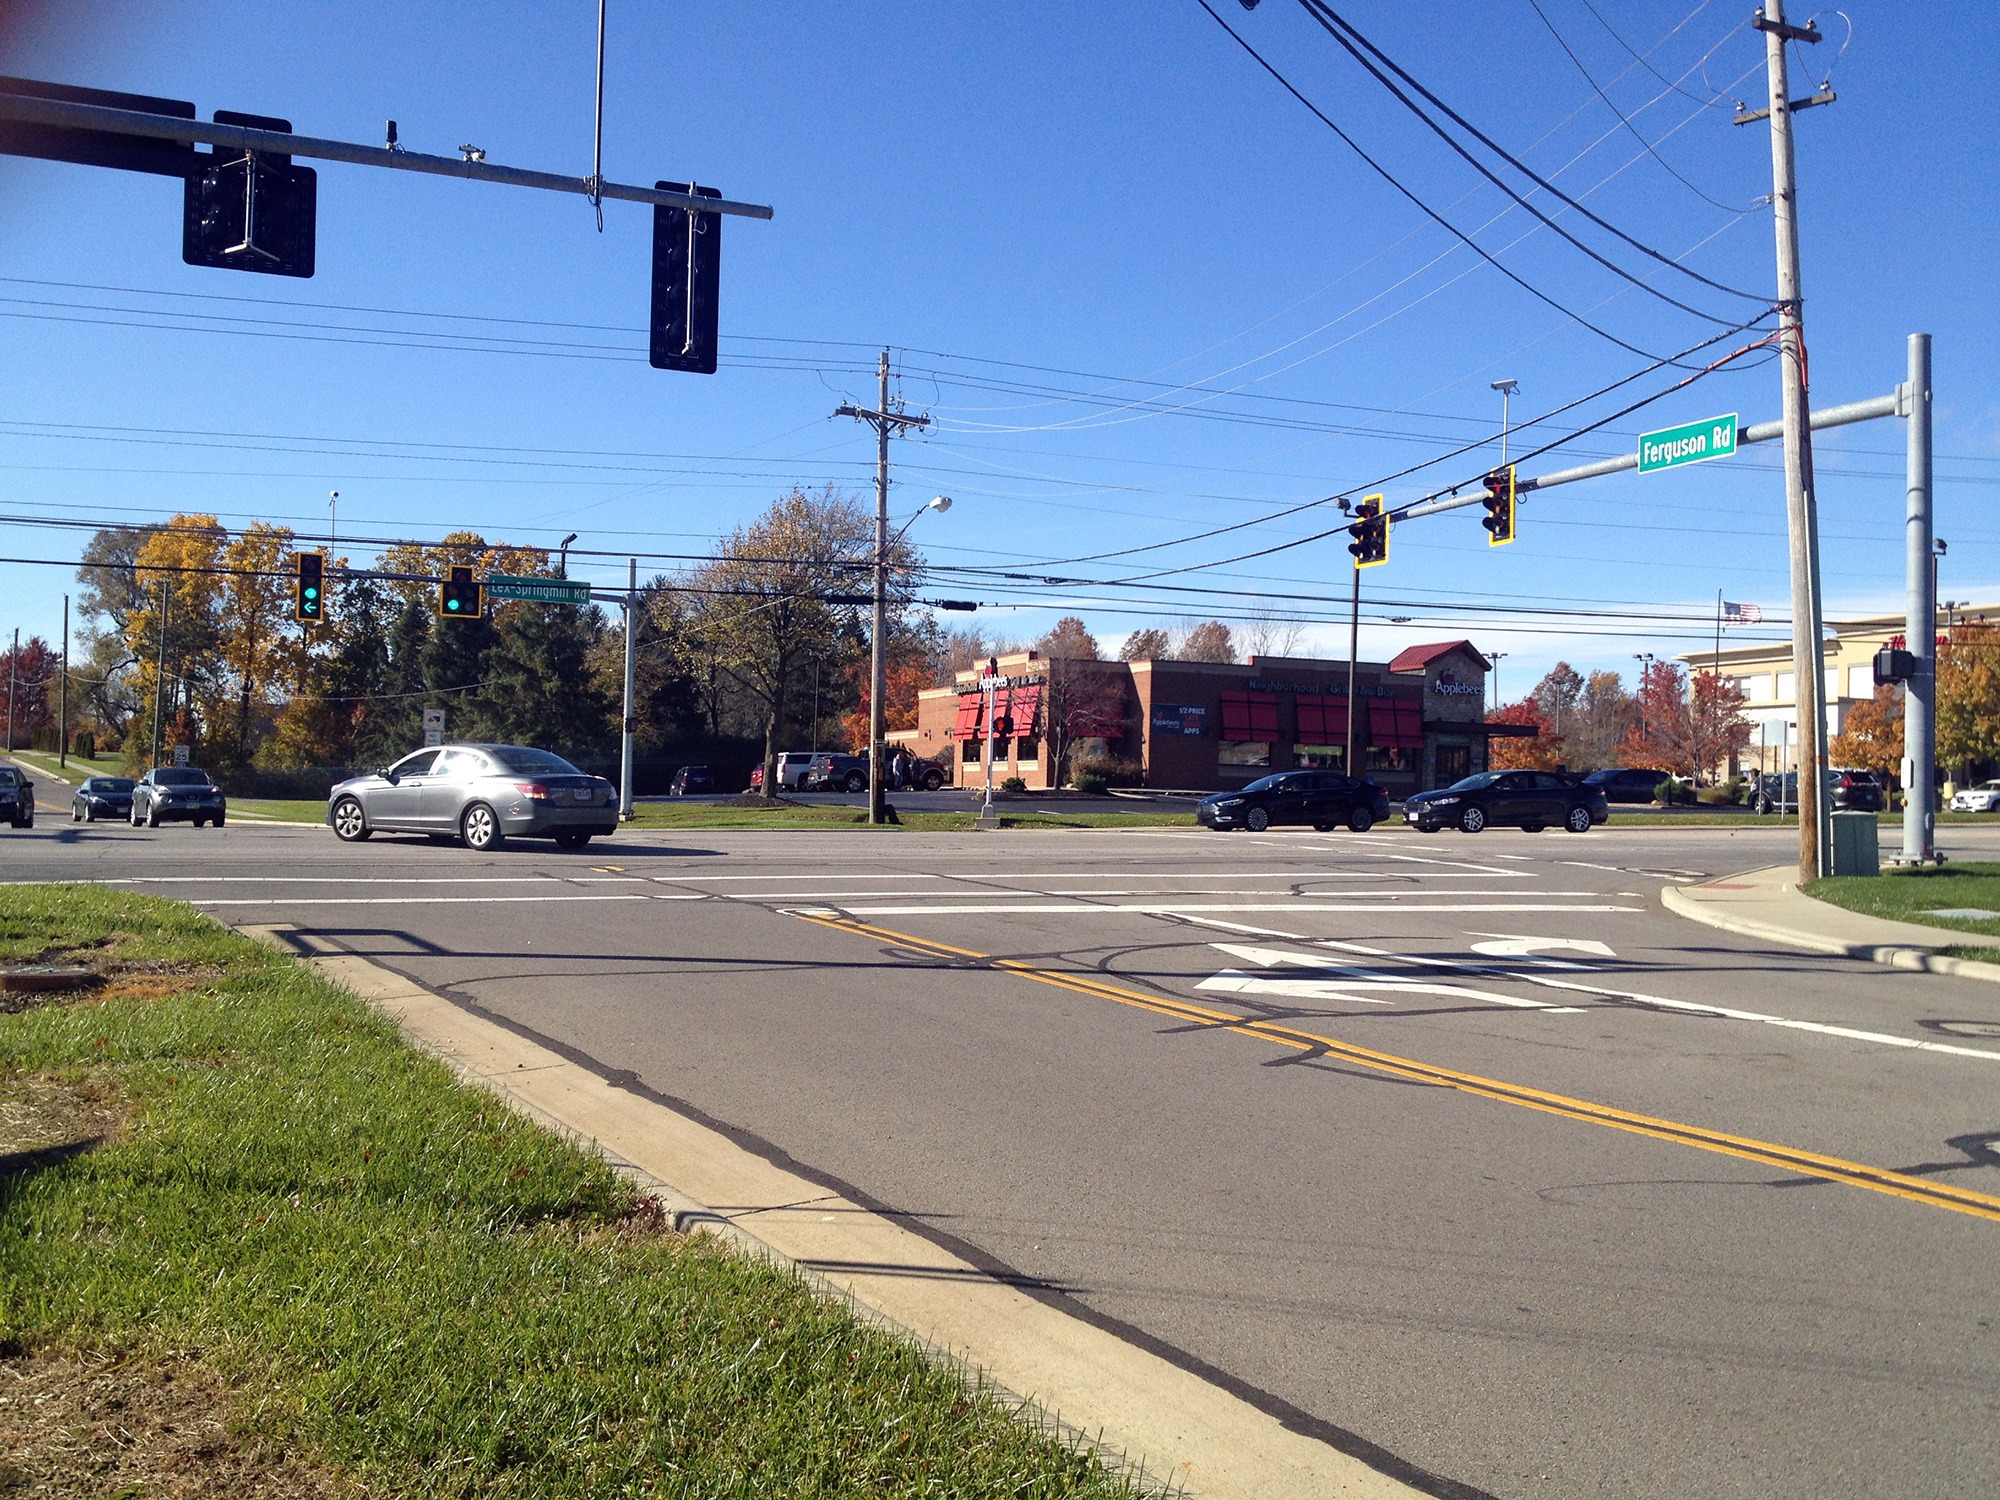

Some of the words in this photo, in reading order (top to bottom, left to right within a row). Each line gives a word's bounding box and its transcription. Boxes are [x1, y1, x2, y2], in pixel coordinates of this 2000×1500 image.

[1644, 435, 1706, 464] Ferguson
[1713, 424, 1731, 449] Rd
[491, 580, 569, 599] Lex-Springmill
[574, 587, 587, 600] Rd
[1248, 679, 1319, 693] Neighborhood
[1377, 686, 1395, 697] Bar
[1188, 707, 1206, 715] PRICE
[1183, 727, 1200, 735] APPS
